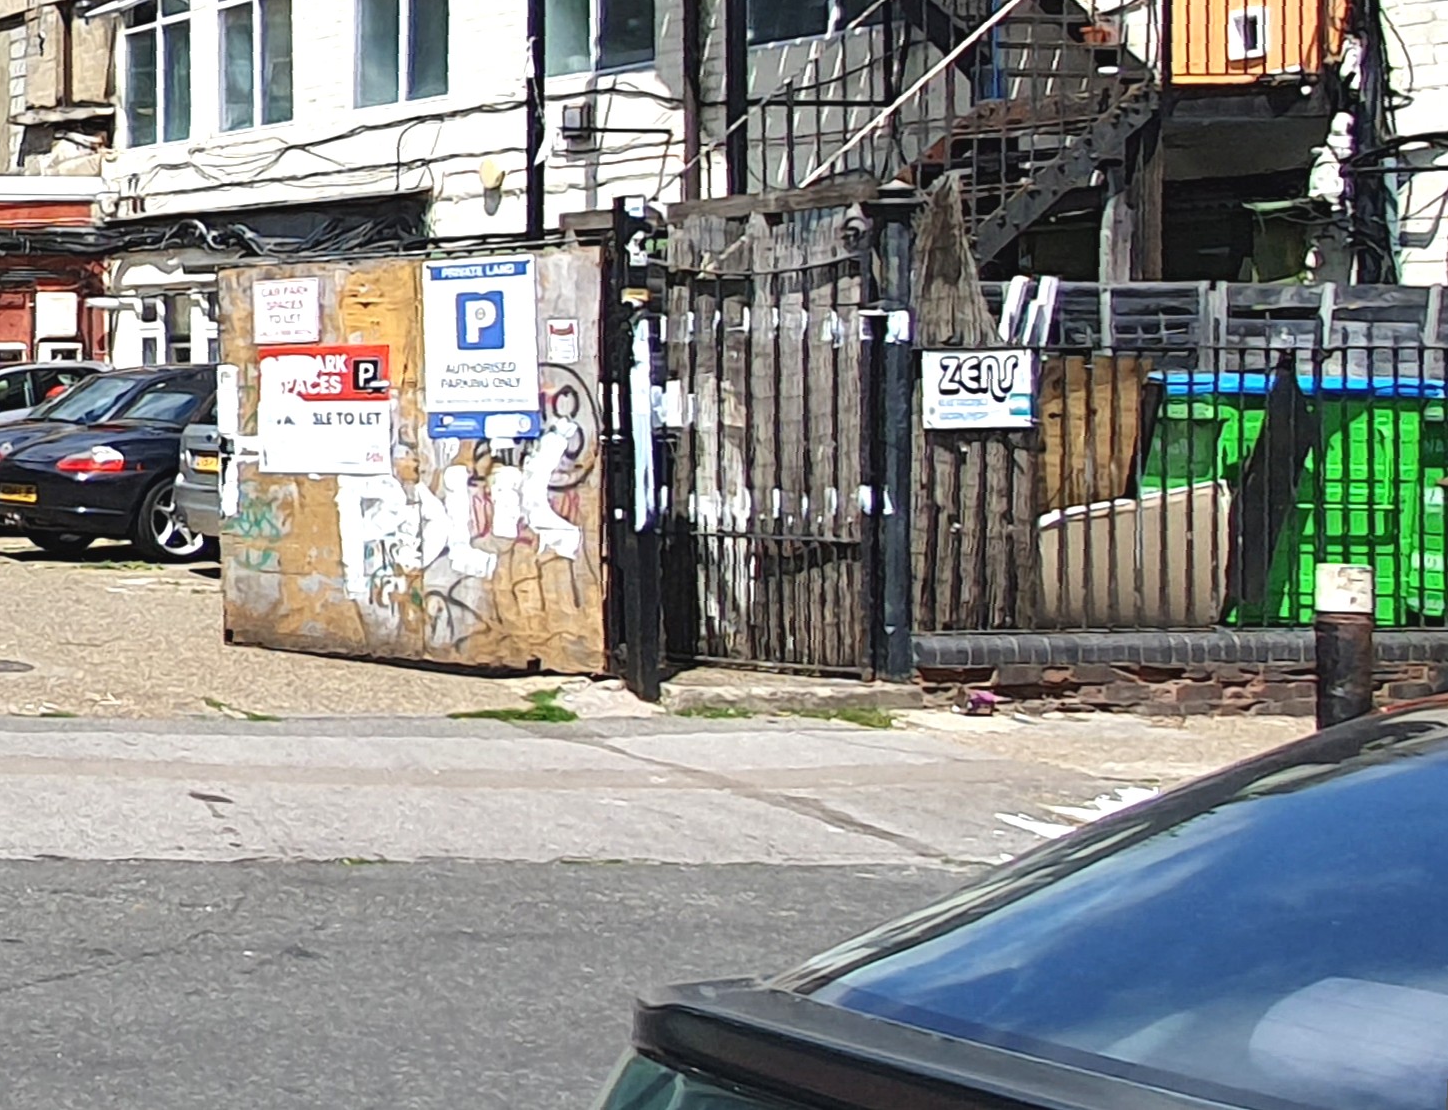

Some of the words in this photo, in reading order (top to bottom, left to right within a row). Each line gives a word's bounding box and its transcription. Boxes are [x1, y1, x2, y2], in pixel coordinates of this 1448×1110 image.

[441, 265, 483, 279] PRIVATE
[486, 263, 514, 276] LAND
[445, 361, 516, 374] AUTHORISED
[493, 377, 521, 388] ONLY
[336, 412, 354, 425] TO
[359, 412, 382, 425] LET
